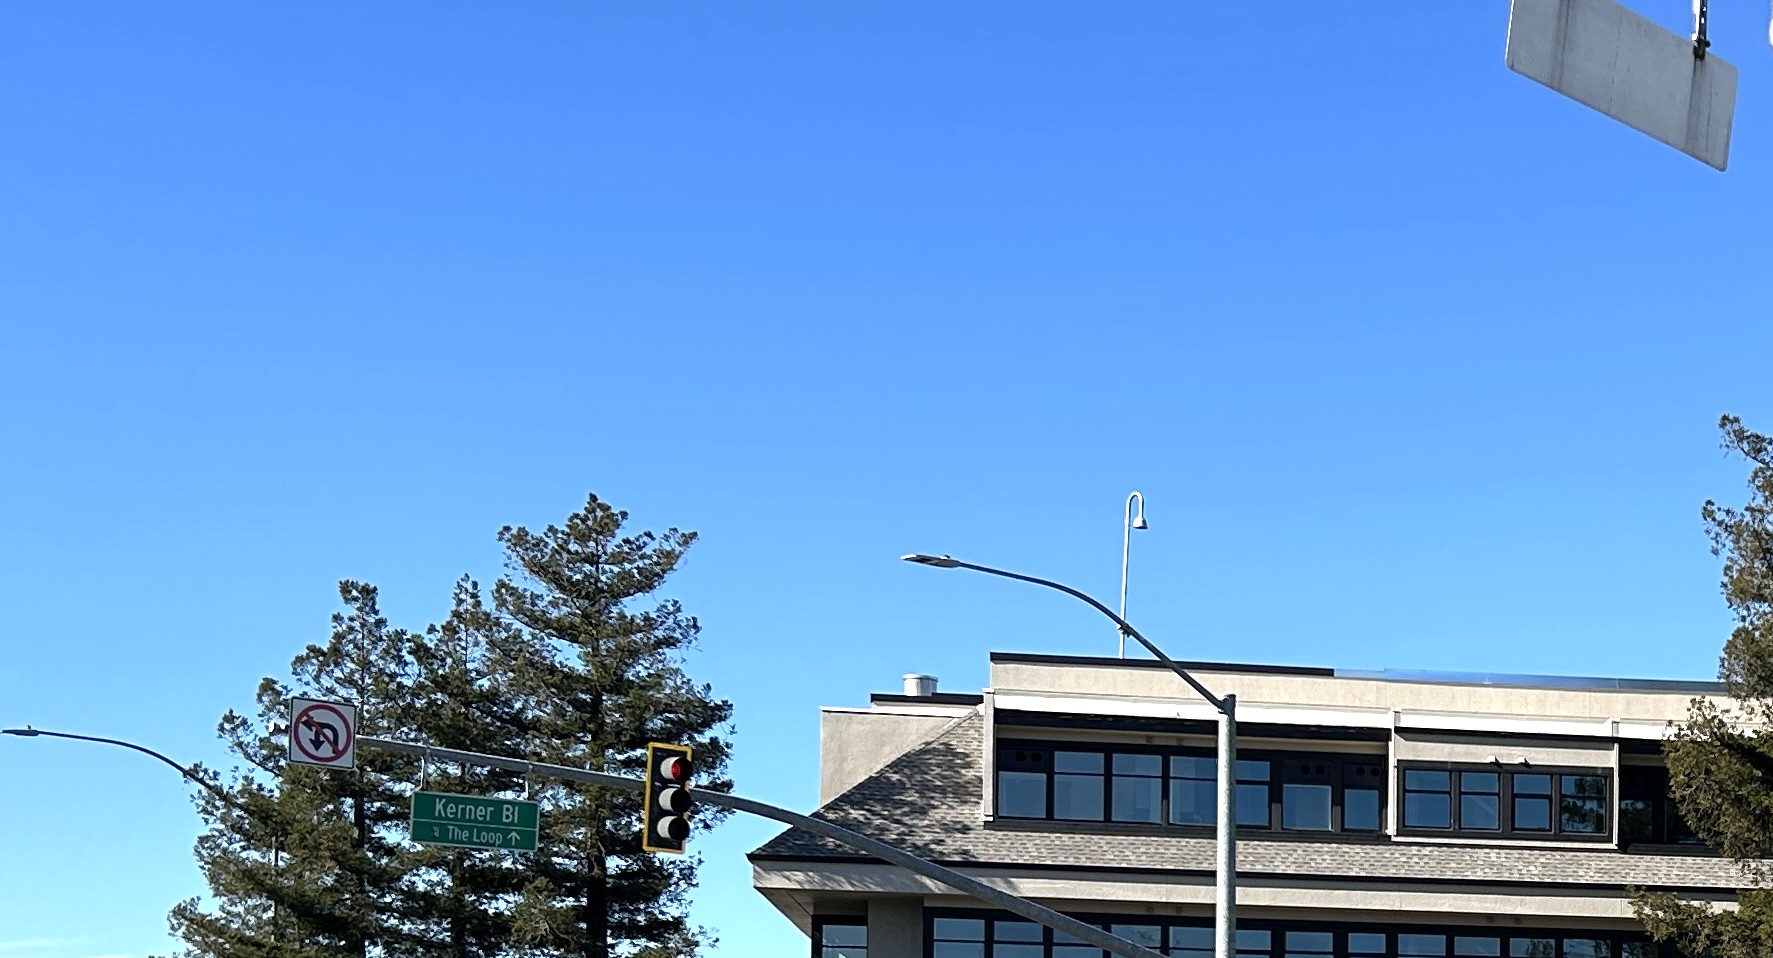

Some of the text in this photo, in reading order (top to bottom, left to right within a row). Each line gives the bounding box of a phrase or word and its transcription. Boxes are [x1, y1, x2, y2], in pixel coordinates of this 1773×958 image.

[435, 798, 519, 823] Kerner Bl
[447, 825, 503, 846] The Loop
